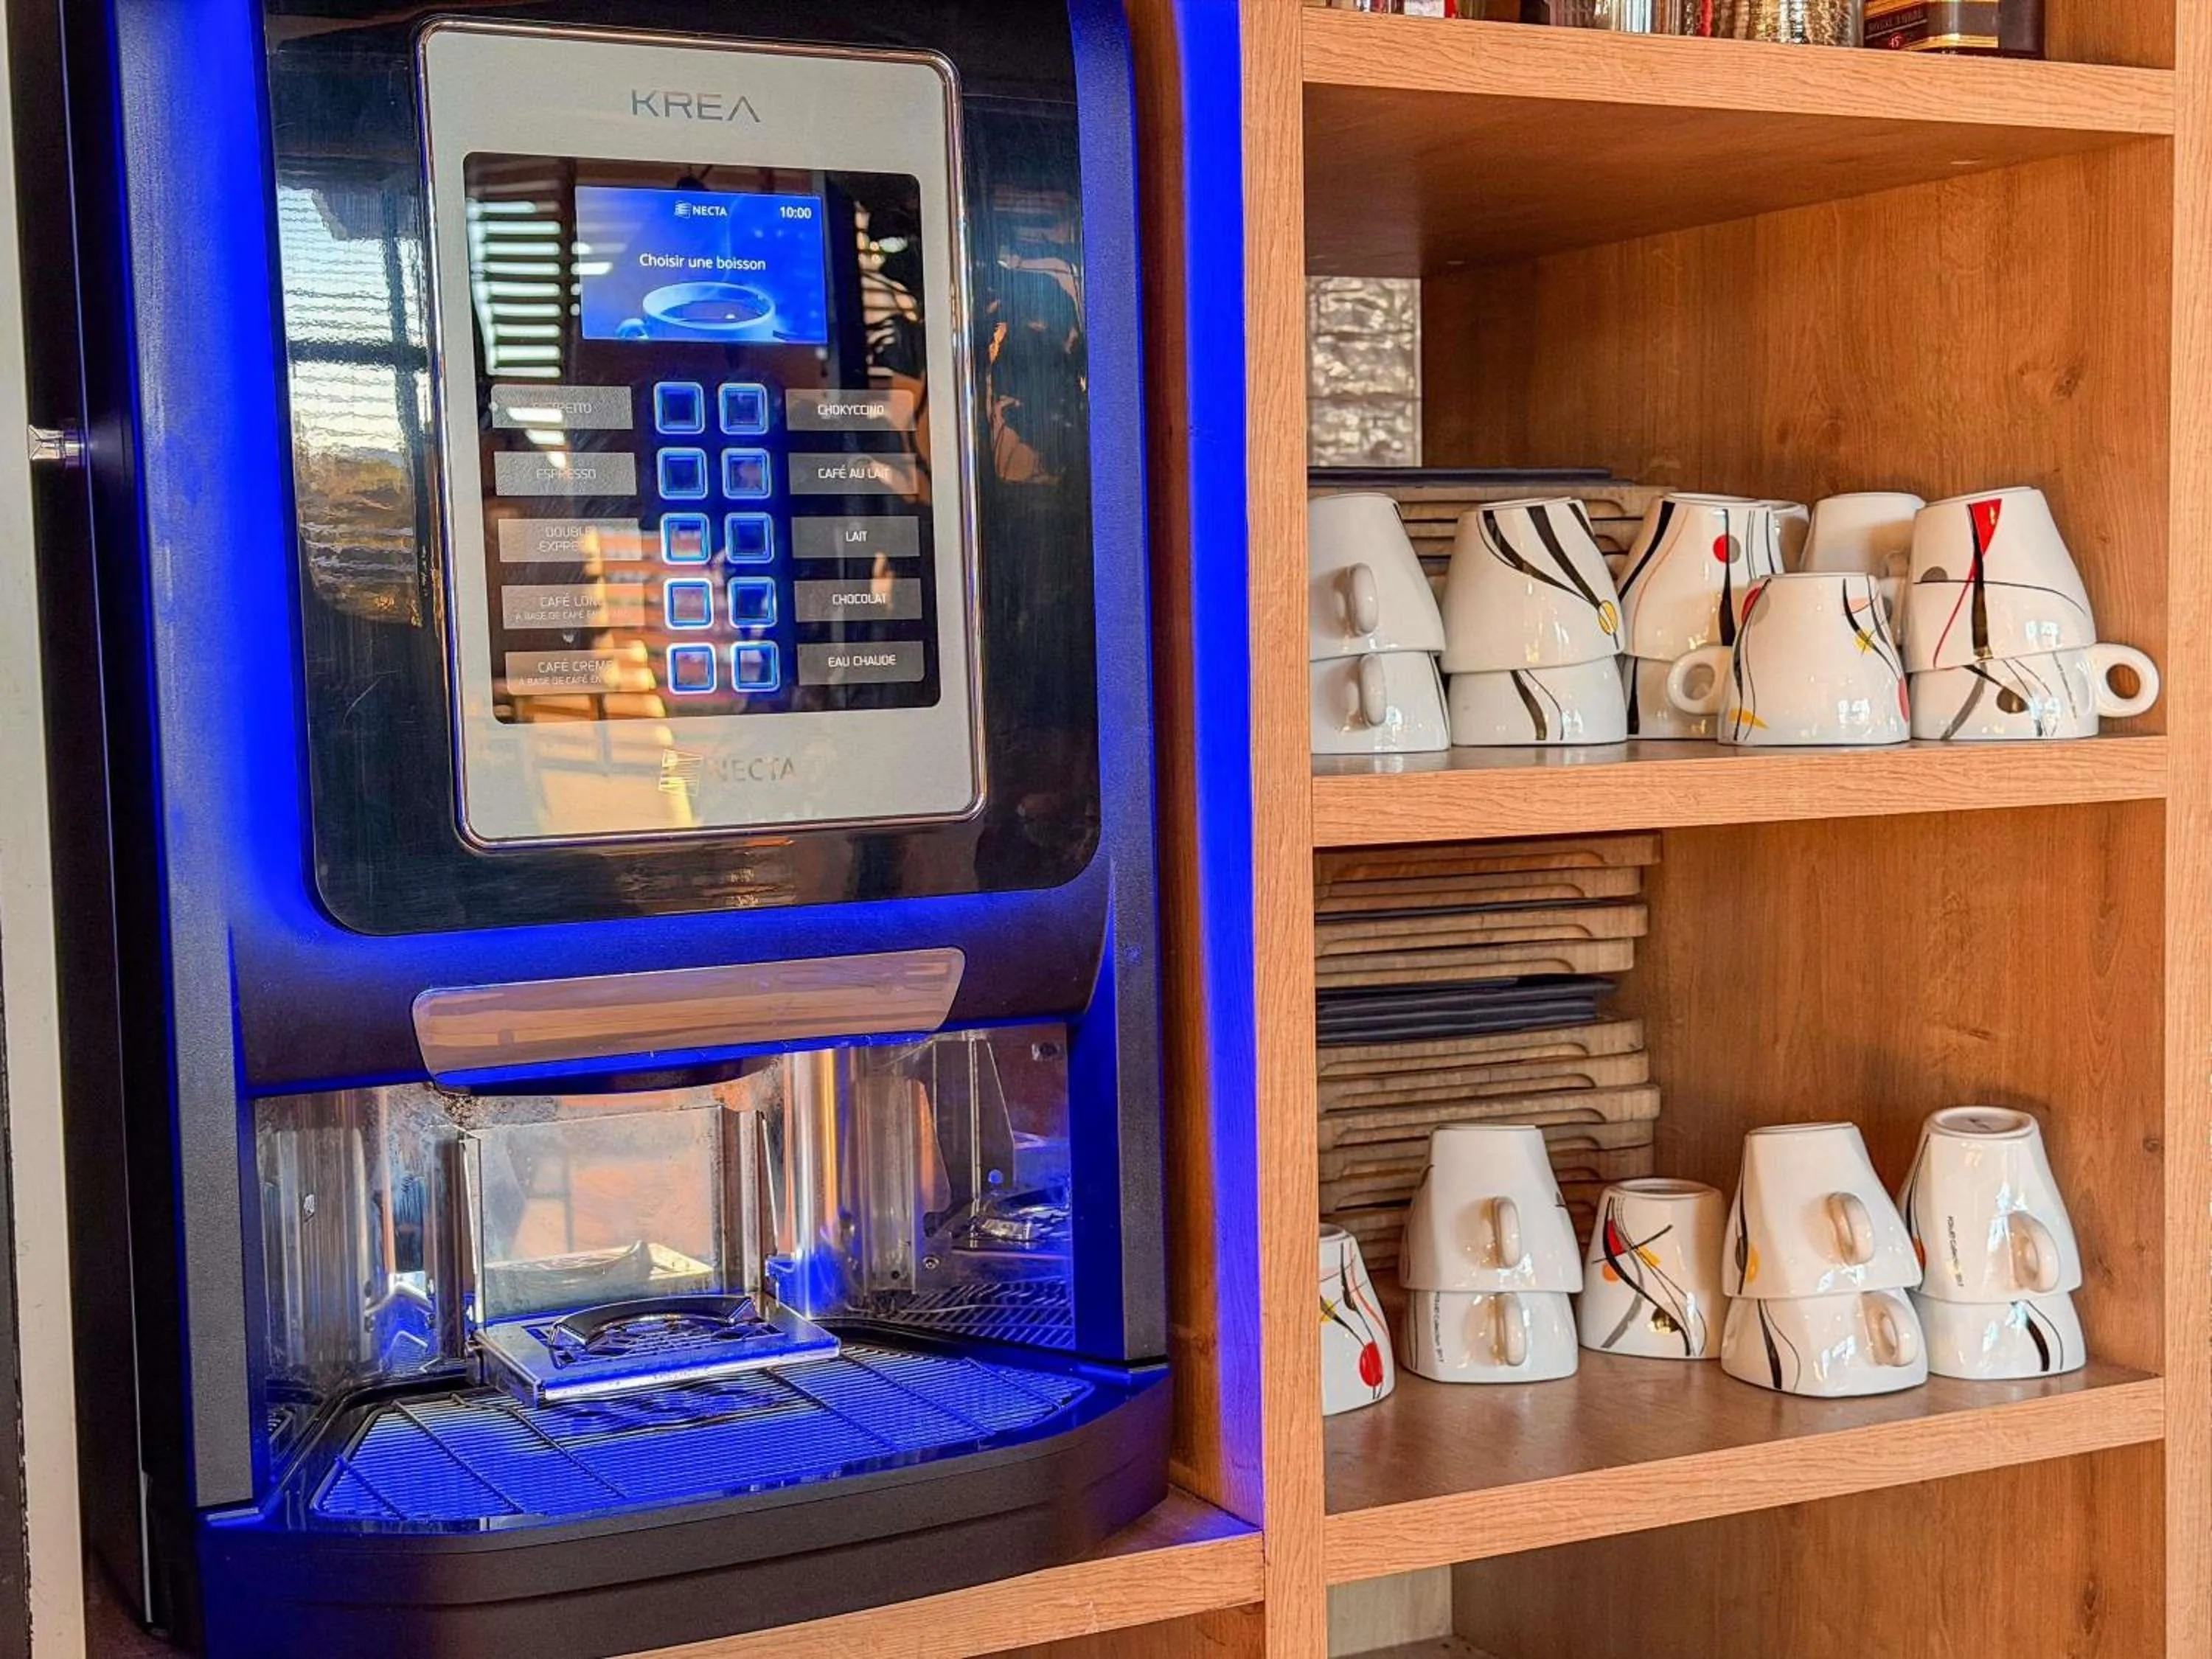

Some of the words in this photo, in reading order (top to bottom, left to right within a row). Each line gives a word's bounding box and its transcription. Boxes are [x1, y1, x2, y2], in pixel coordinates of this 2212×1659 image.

[631, 88, 761, 123] KREA
[692, 206, 728, 217] NECTA
[779, 206, 812, 219] 10:00
[639, 253, 684, 268] Choisir
[688, 257, 713, 268] une
[716, 255, 766, 271] boisson
[817, 403, 885, 416] CHOKYCCINO
[817, 465, 846, 479] CAFÉ
[849, 467, 865, 479] AU
[868, 467, 890, 479] LAIT
[845, 530, 868, 542] LAIT
[540, 593, 571, 608] CAFÉ
[574, 595, 604, 608] LON
[832, 593, 888, 605] CHOCOLAT
[538, 658, 568, 673] CAFÉ
[827, 655, 850, 667] EAU
[852, 653, 897, 667] CHAUDE
